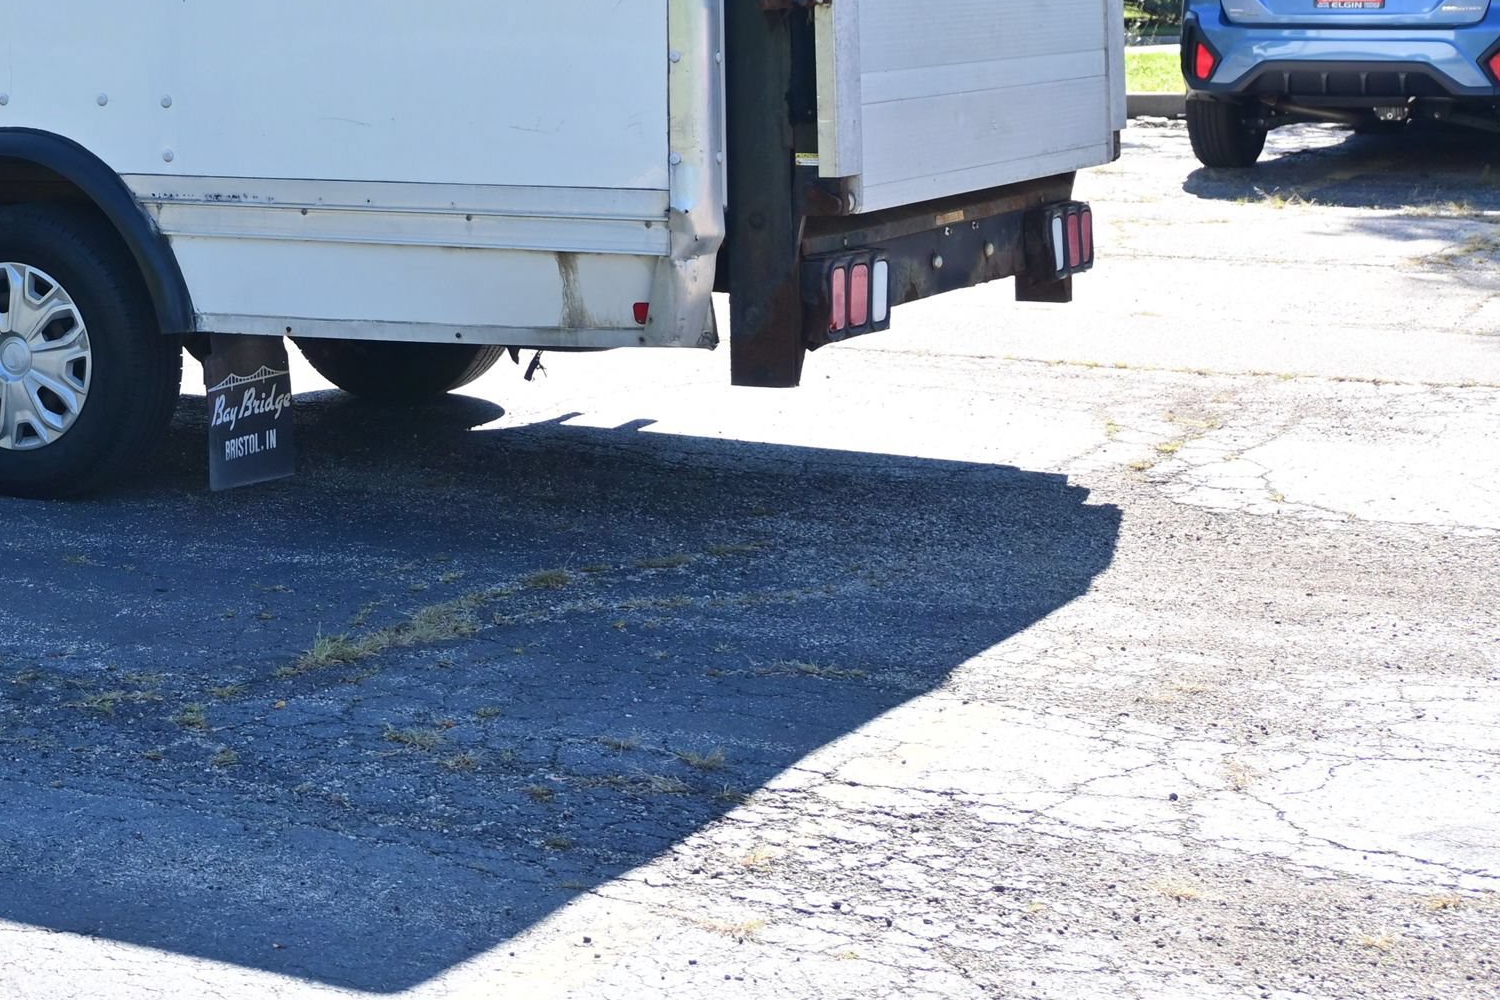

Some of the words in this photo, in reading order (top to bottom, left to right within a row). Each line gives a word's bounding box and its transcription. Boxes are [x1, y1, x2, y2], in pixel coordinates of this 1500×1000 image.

[211, 394, 238, 431] Bay
[238, 383, 291, 420] Bridge
[266, 428, 276, 450] IN
